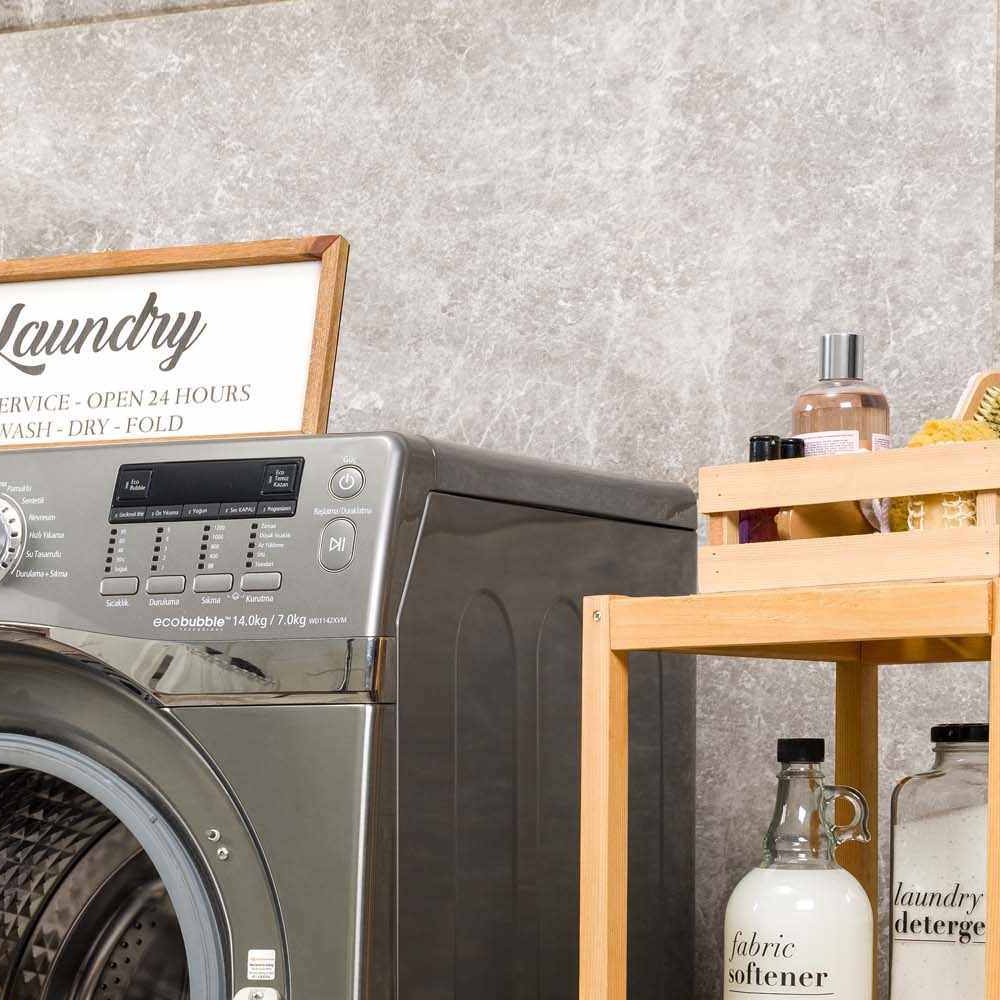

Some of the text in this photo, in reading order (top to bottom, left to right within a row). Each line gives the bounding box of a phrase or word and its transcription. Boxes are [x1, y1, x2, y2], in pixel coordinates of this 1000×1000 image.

[87, 389, 145, 409] OPEN
[148, 389, 171, 406] 24
[174, 384, 251, 405] HOURS
[67, 417, 109, 438] DRY
[125, 414, 184, 435] FOLD
[232, 615, 268, 629] 14.0kg
[277, 613, 307, 627] 7.0kg
[893, 881, 985, 915] laundry
[728, 930, 796, 962] fabric
[728, 961, 829, 987] softener
